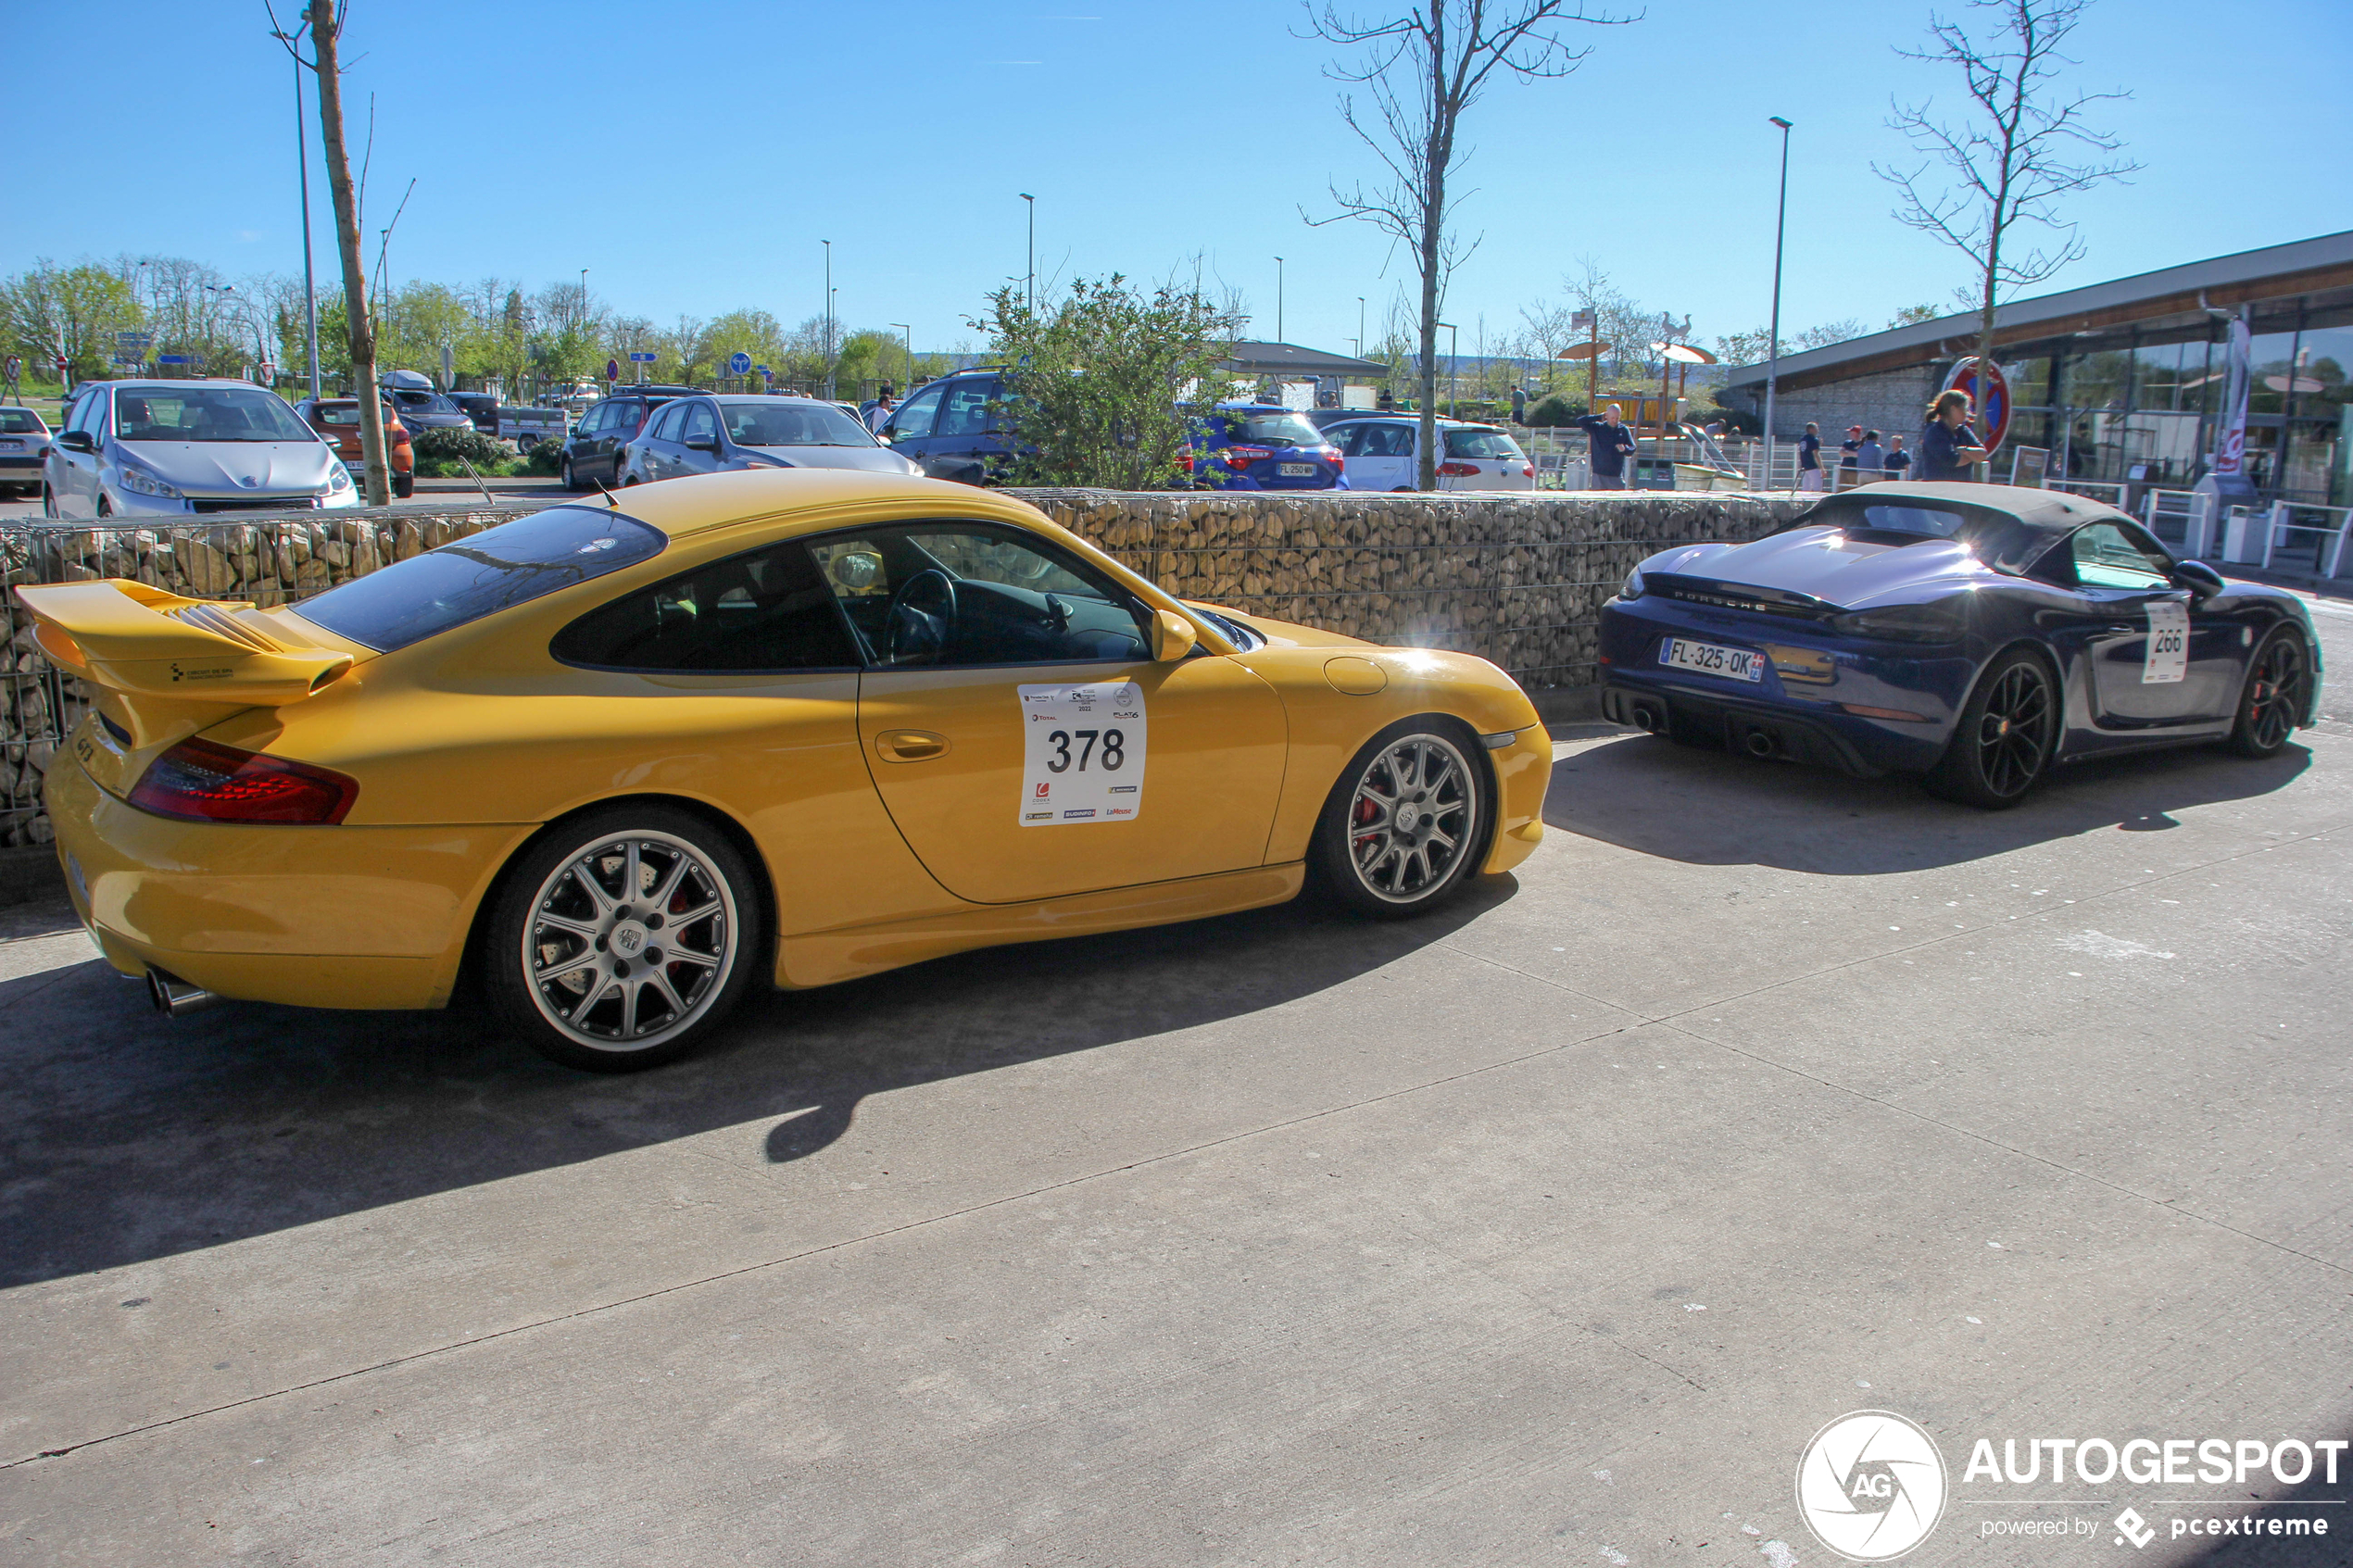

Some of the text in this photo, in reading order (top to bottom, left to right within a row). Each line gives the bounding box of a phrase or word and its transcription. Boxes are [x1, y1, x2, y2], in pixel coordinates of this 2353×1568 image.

[1675, 591, 1766, 611] PORSCHE
[2155, 628, 2183, 654] 266
[1751, 668, 1760, 679] 73
[78, 738, 94, 761] GT3
[1047, 728, 1125, 773] 378
